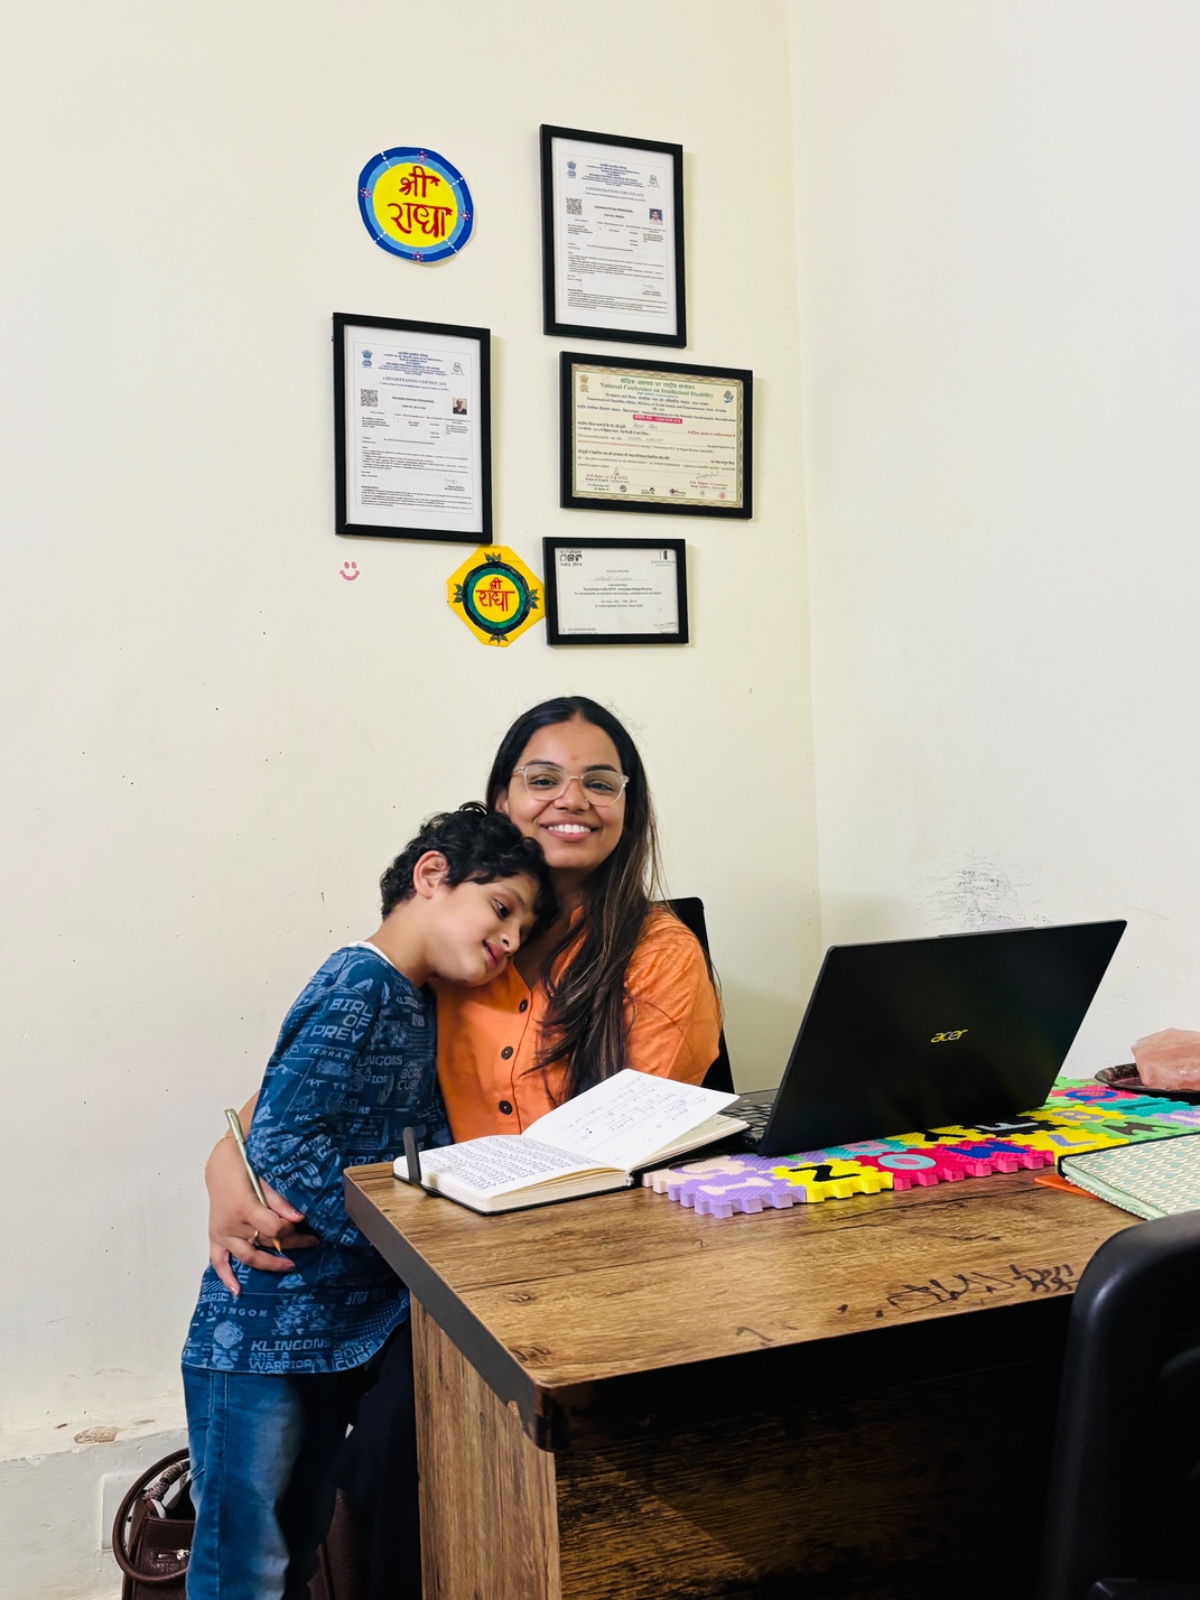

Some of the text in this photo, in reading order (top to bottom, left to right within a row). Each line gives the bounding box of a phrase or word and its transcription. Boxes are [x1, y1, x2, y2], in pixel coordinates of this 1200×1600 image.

[399, 165, 441, 198] श्री
[387, 202, 453, 238] राधा
[600, 382, 622, 390] National
[475, 589, 515, 612] राधा
[343, 1014, 371, 1029] OF
[310, 1025, 364, 1043] PREY
[930, 1029, 968, 1043] acer
